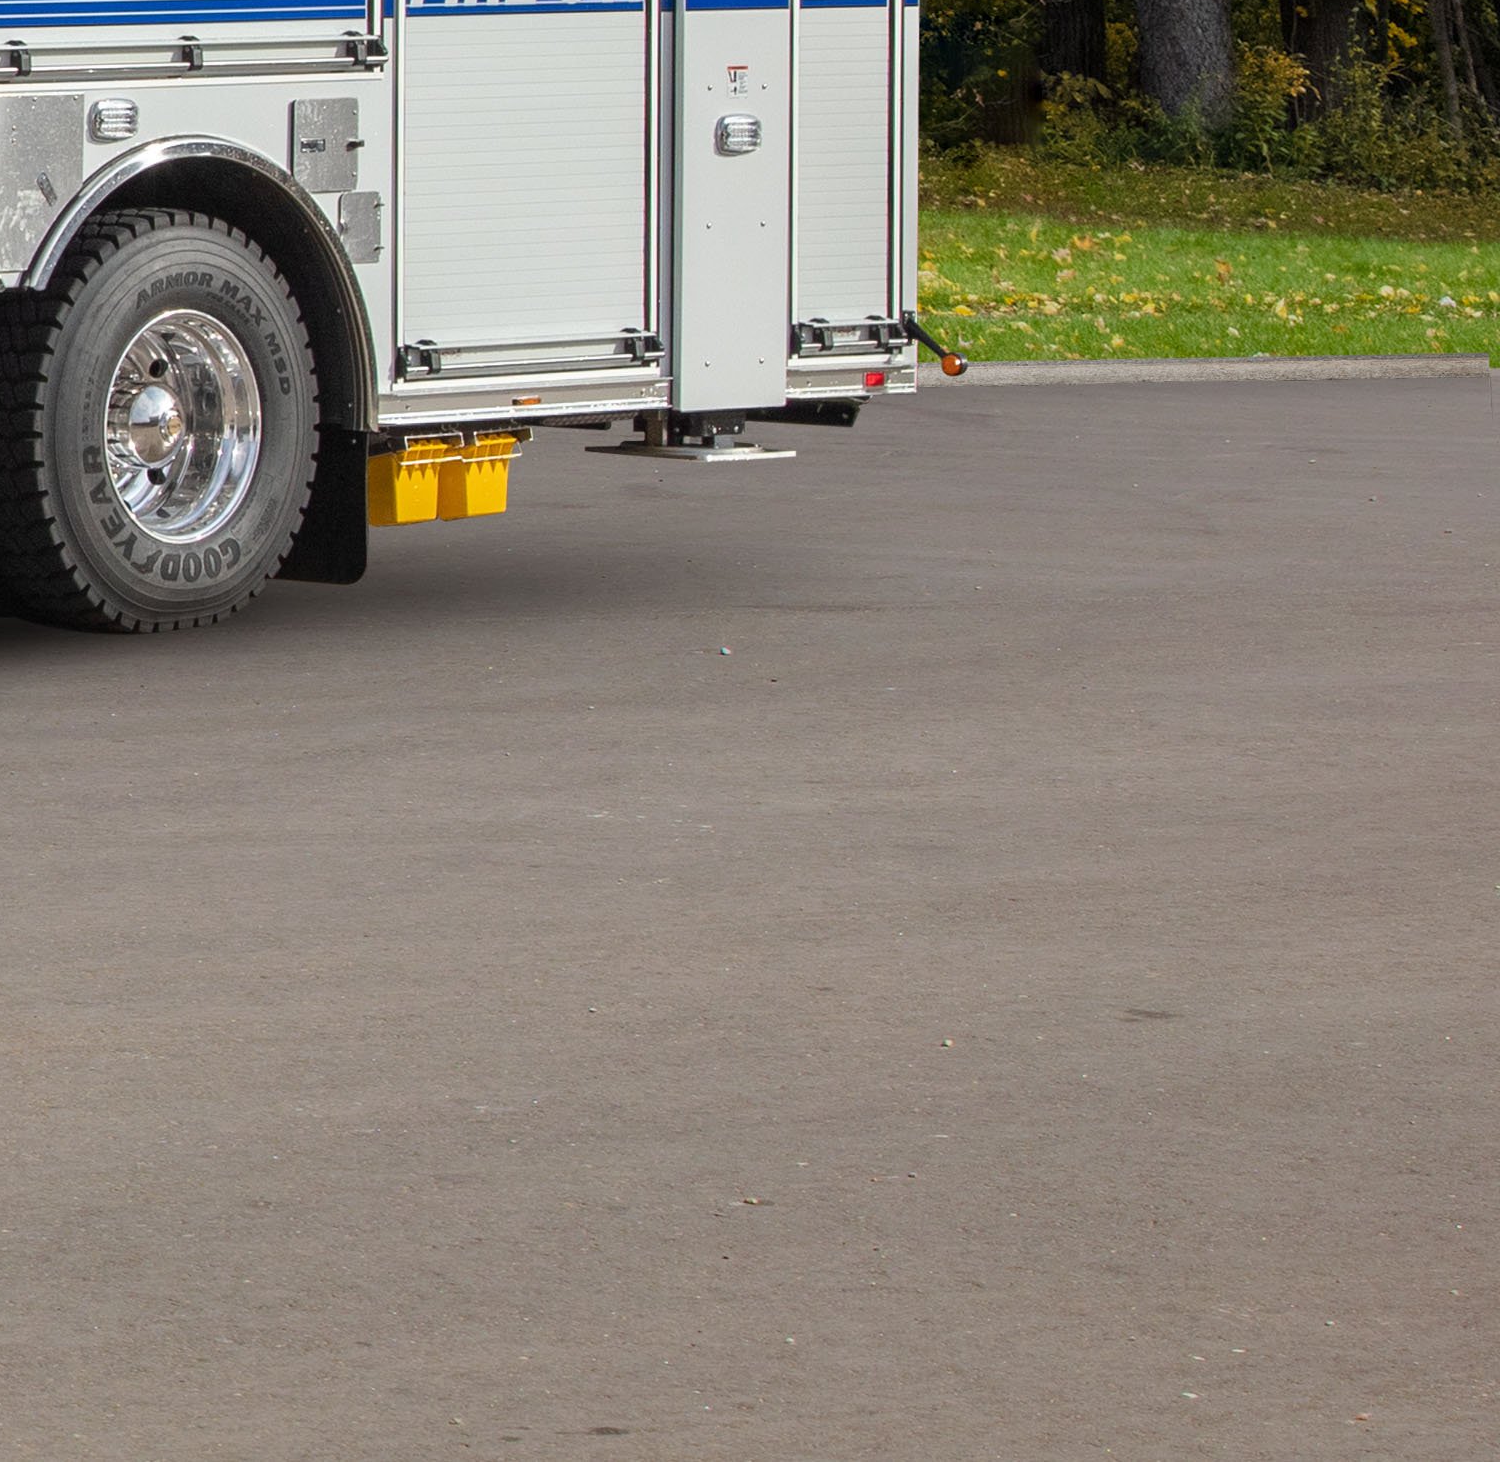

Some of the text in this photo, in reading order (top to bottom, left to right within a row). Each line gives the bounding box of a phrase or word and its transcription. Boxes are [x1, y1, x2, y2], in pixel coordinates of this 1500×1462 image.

[135, 271, 214, 311] ARMOR
[220, 279, 268, 327] MAX
[83, 445, 242, 583] GOODYEAR
